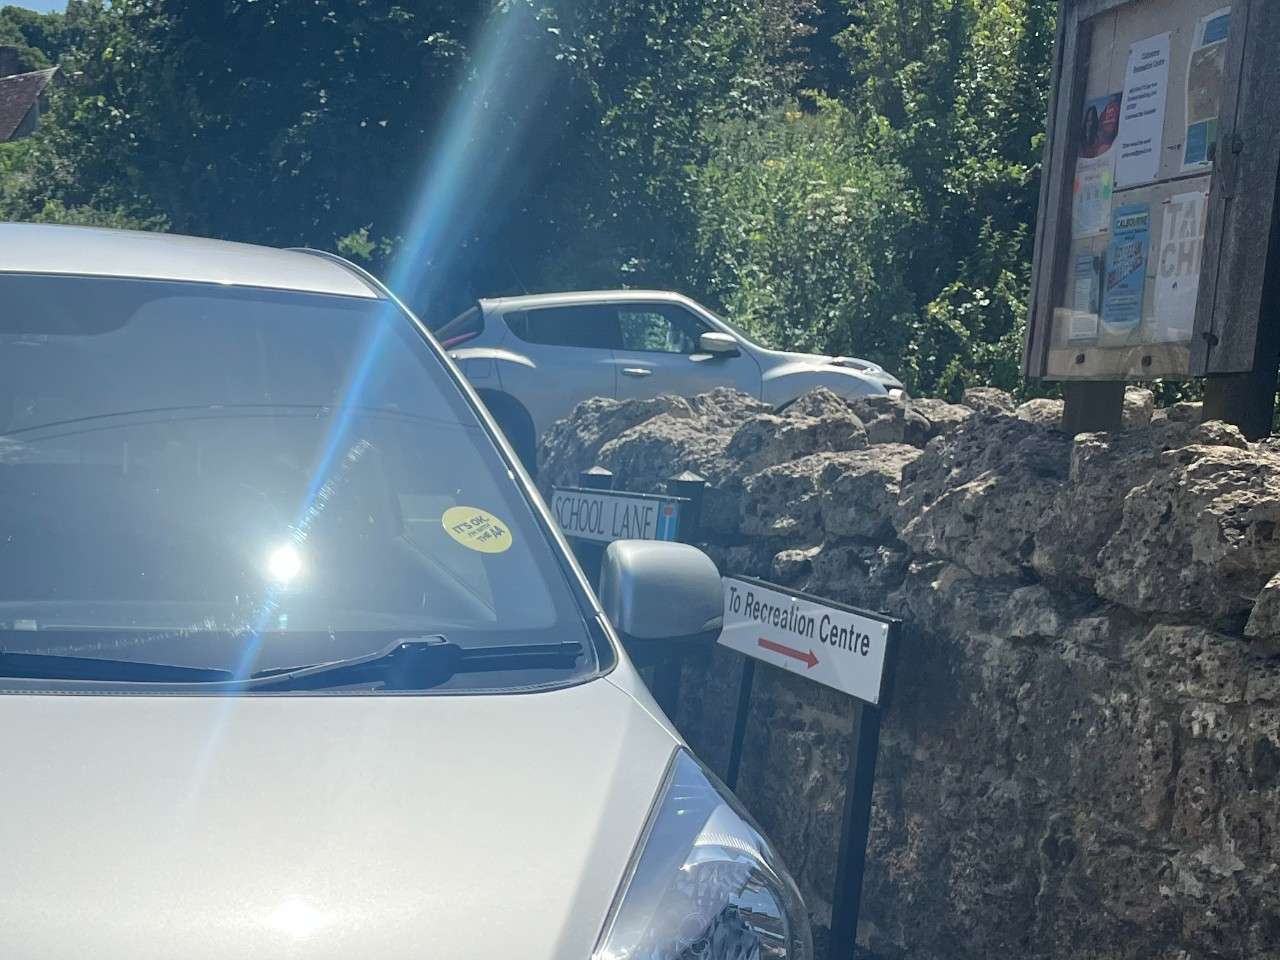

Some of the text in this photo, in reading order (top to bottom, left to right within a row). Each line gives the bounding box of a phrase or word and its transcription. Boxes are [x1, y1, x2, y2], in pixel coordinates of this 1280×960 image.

[556, 495, 653, 540] SCHOOL LANE
[729, 586, 870, 657] To Recreation Centre
